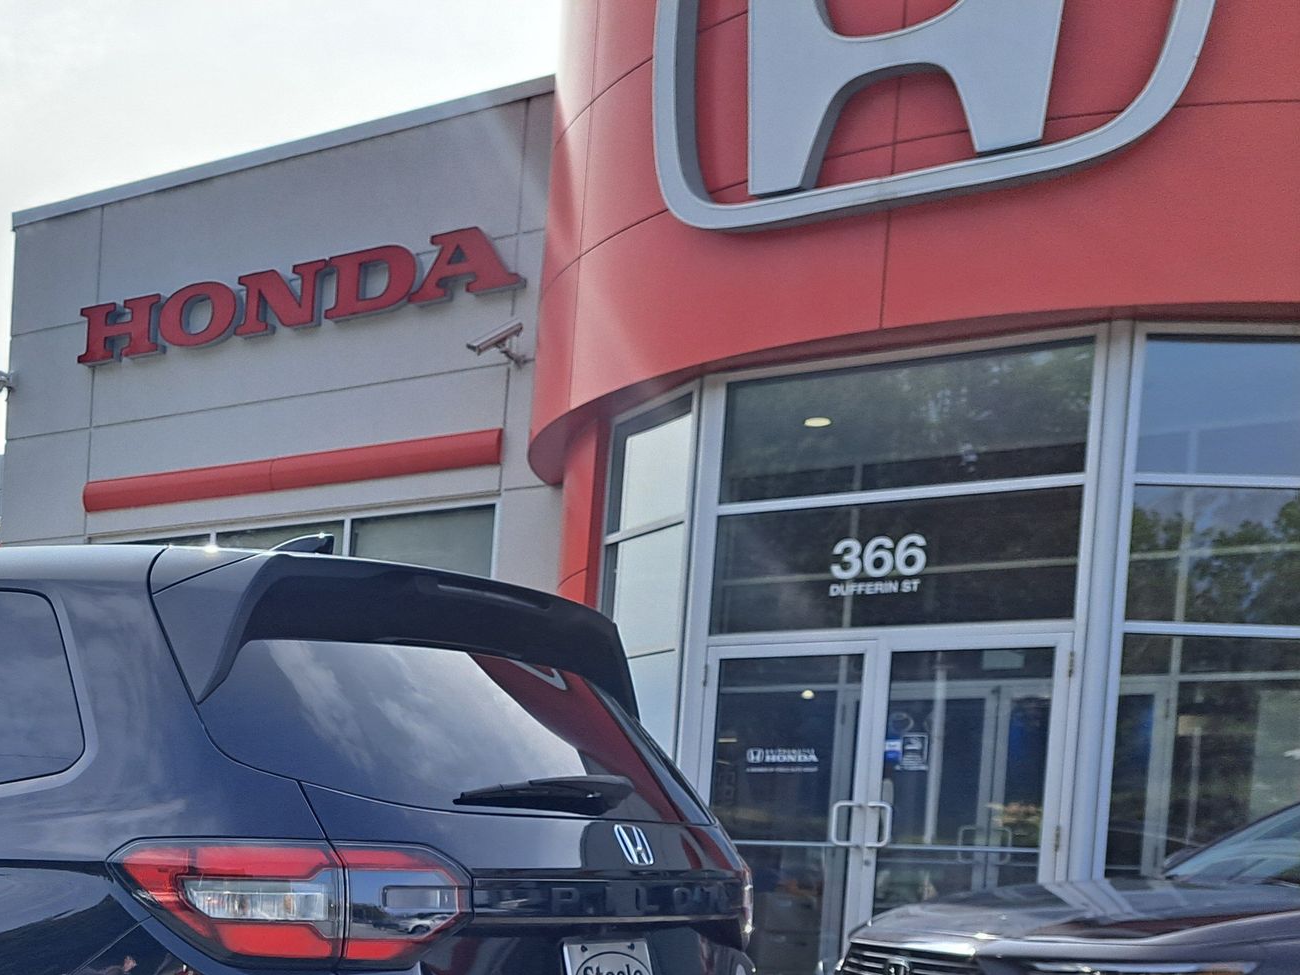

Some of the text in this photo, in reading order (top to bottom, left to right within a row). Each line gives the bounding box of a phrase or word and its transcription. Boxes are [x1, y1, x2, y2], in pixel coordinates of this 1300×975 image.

[78, 226, 526, 368] HONDA
[830, 533, 927, 580] 366
[829, 579, 921, 597] DUFFERIN ST
[765, 755, 819, 763] HONDA
